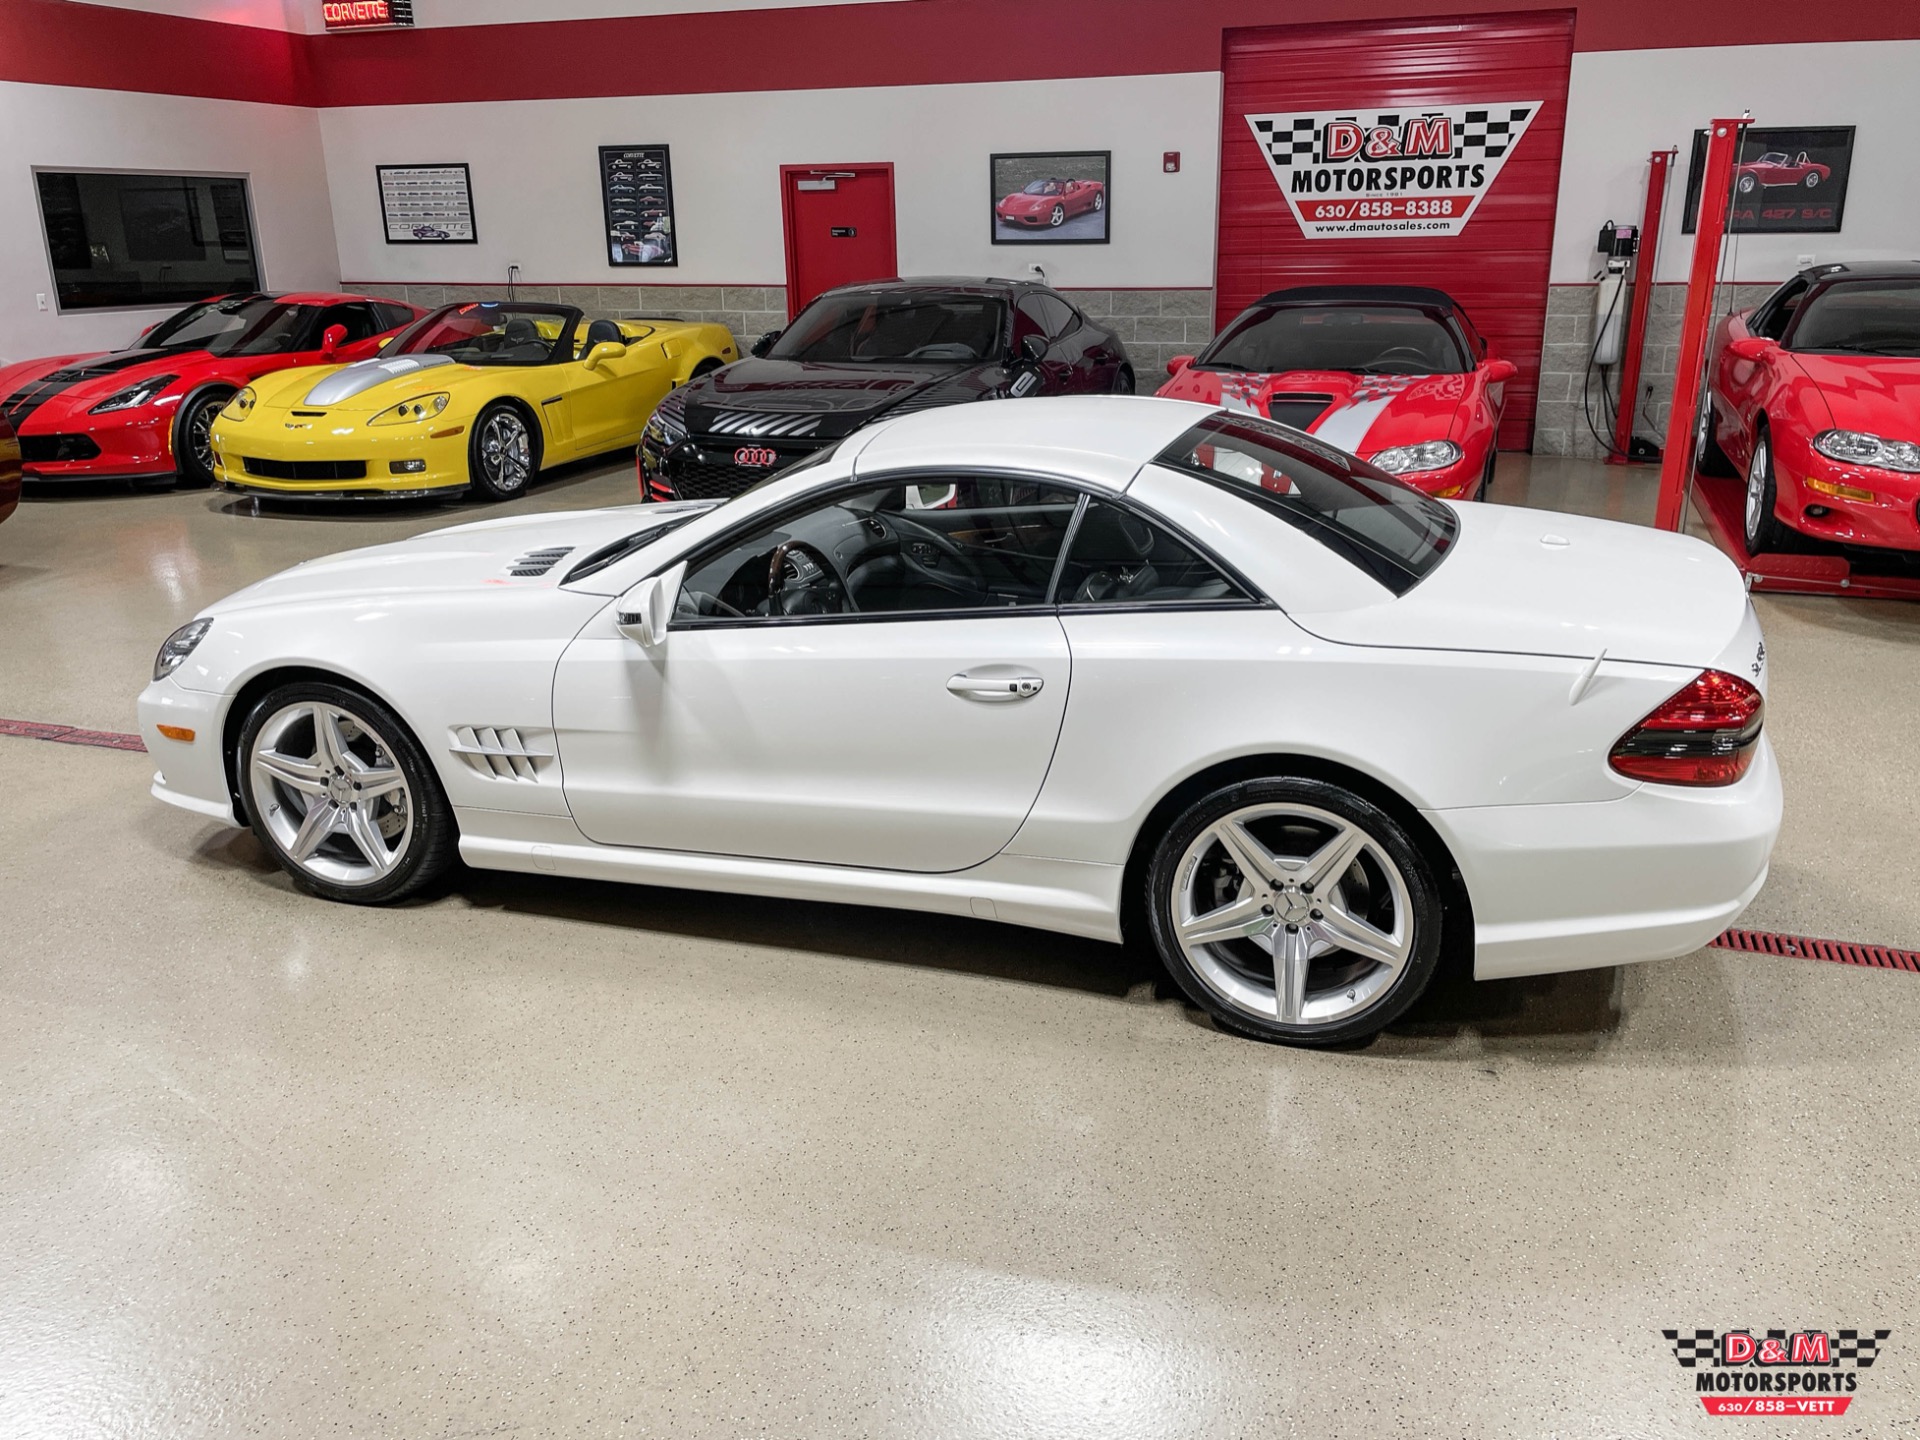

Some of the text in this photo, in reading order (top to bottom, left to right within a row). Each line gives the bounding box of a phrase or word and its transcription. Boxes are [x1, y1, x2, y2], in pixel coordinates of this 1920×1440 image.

[323, 1, 388, 21] CORVETTE
[1322, 116, 1454, 163] D&M
[1291, 164, 1485, 193] MOTORSPORTS
[1315, 200, 1453, 219] 630/858-8388
[1762, 208, 1796, 219] 427
[1315, 221, 1450, 233] www.dmautosales.com
